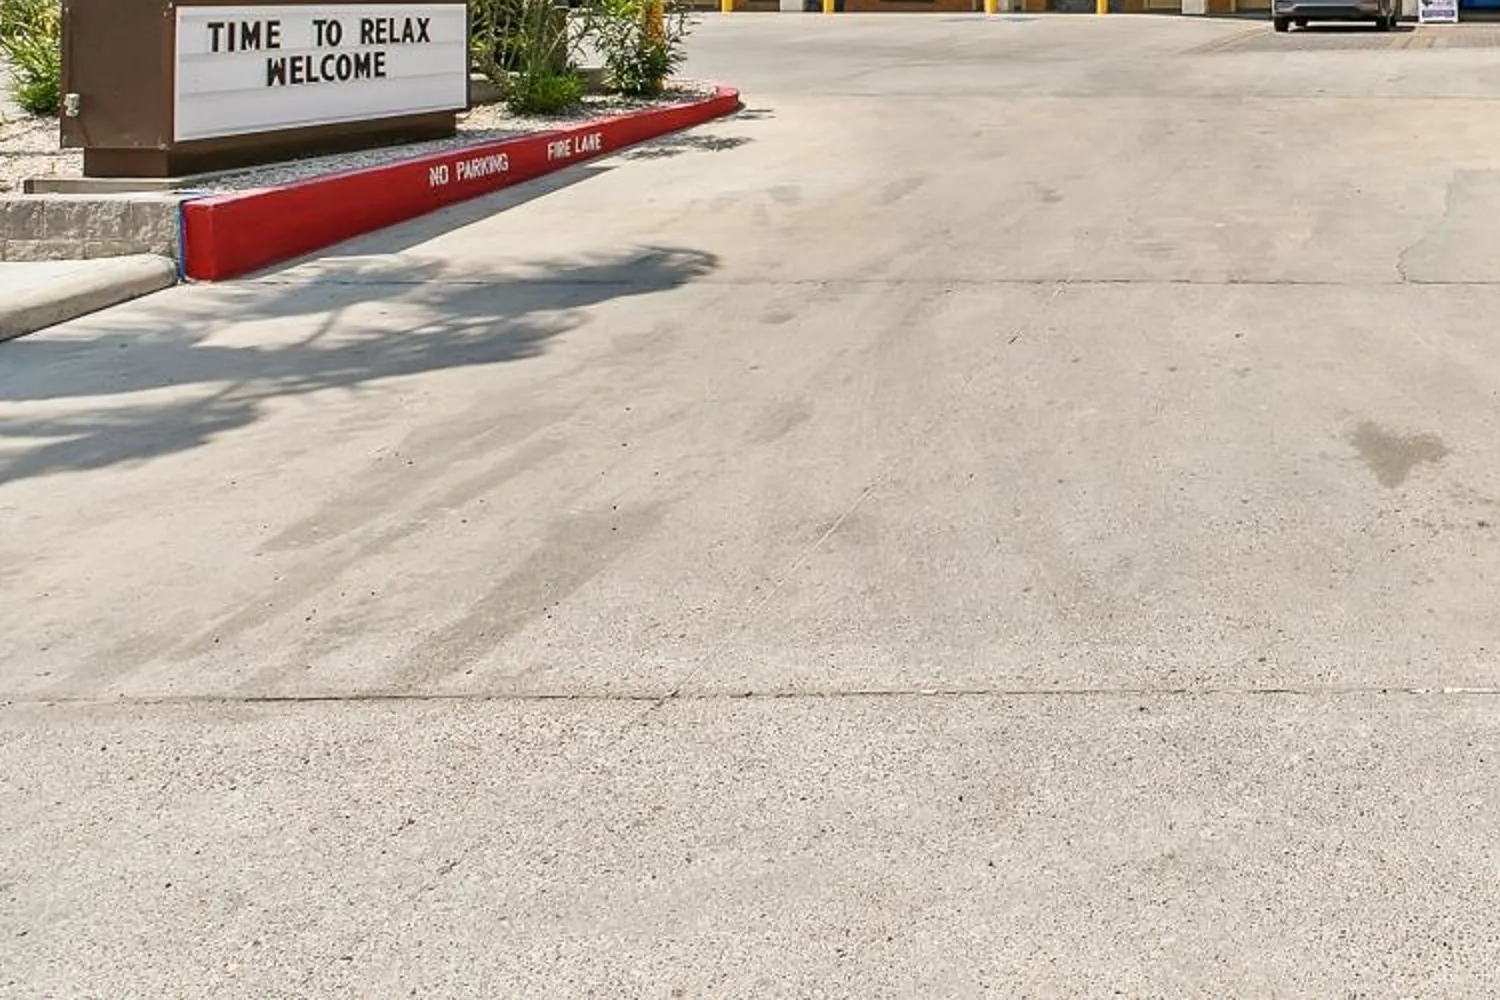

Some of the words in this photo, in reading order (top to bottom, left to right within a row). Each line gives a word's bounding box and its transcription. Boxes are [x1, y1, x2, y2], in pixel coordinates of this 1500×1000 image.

[207, 20, 281, 52] TIME
[312, 19, 343, 47] TO
[360, 17, 431, 44] RELAX
[266, 52, 386, 87] WELCOME
[547, 139, 572, 161] FIRE
[575, 132, 602, 153] LANE
[429, 165, 449, 187] NO
[456, 153, 509, 181] PARKING
